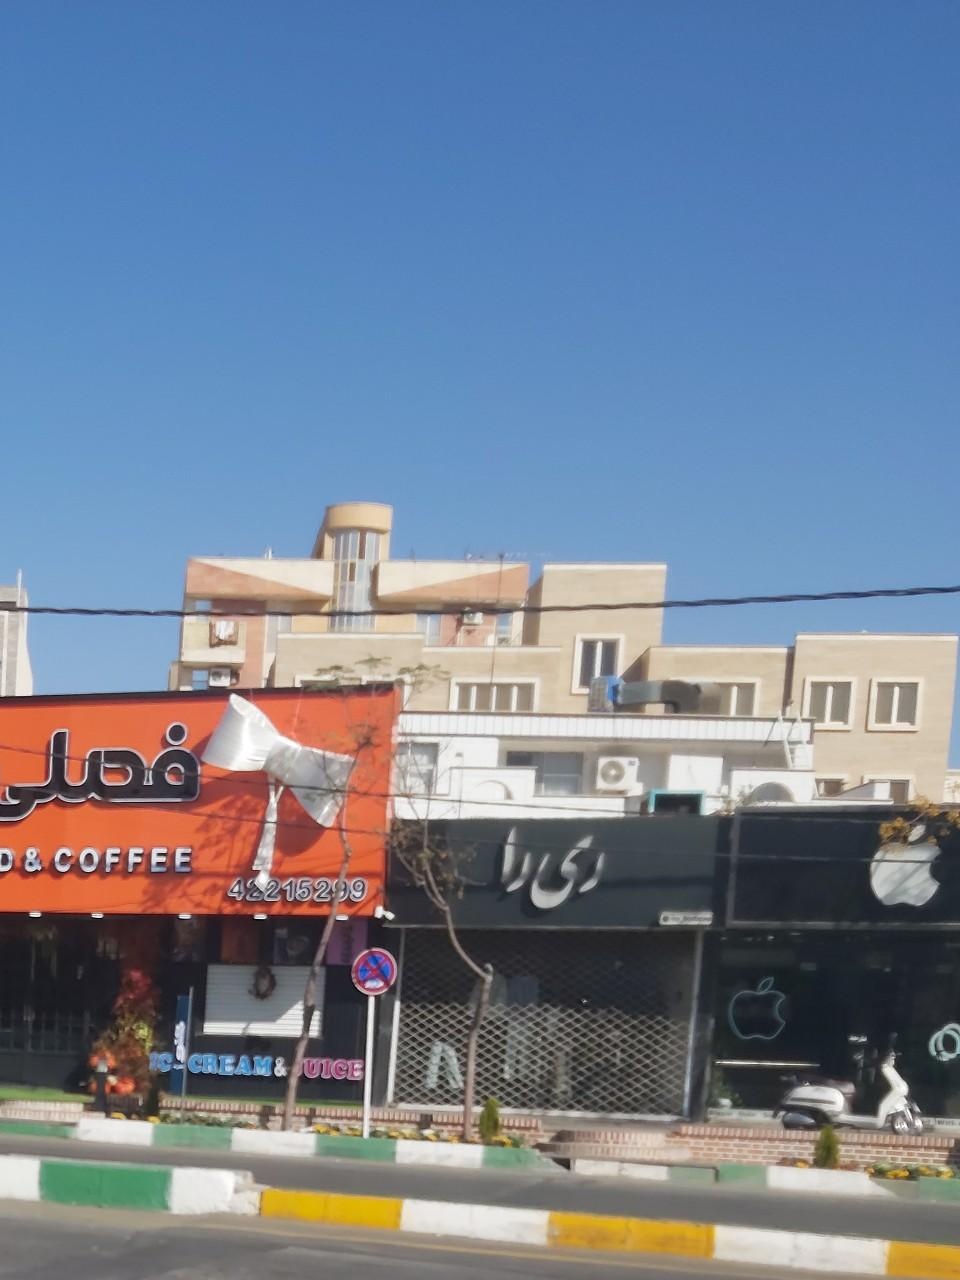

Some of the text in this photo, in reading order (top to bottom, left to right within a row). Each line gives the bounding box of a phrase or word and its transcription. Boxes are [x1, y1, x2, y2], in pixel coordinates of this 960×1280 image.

[23, 848, 42, 872] &
[53, 847, 192, 873] COFFEE
[227, 876, 368, 903] 42215299
[187, 1053, 272, 1077] CREAM
[273, 1057, 288, 1077] &
[296, 1057, 364, 1081] UICE
